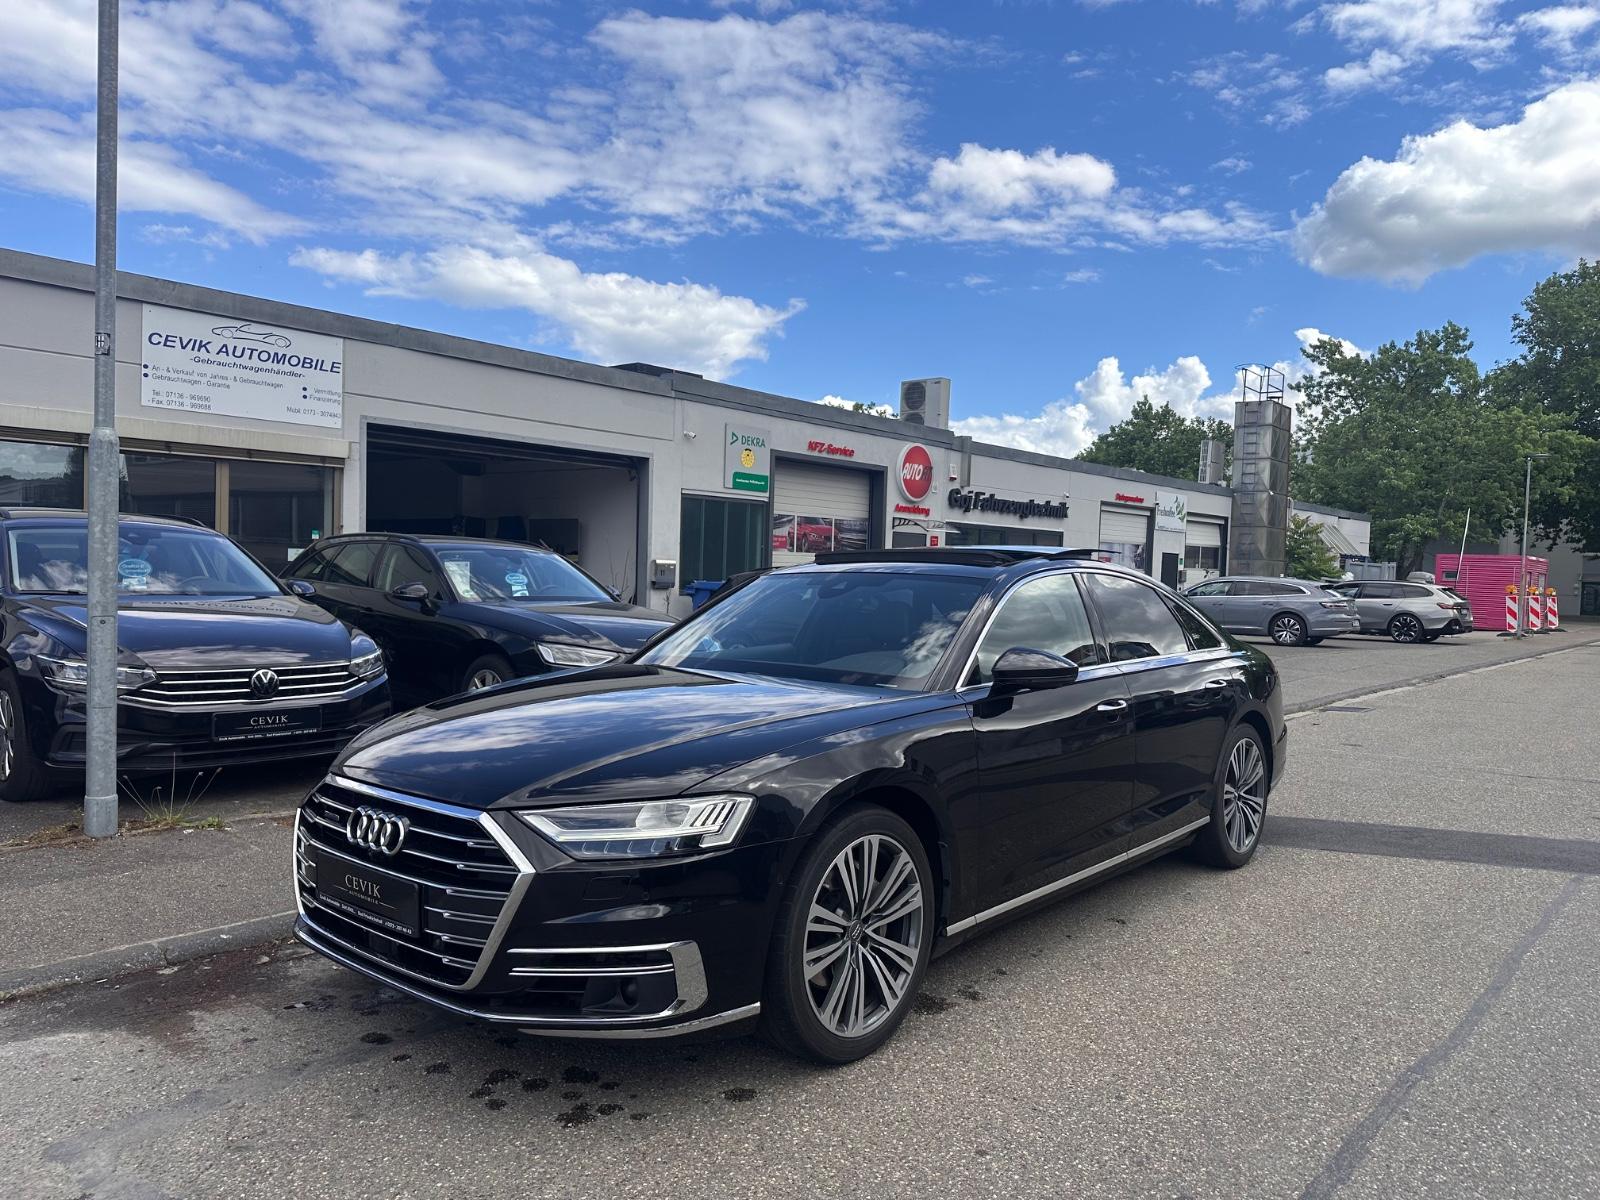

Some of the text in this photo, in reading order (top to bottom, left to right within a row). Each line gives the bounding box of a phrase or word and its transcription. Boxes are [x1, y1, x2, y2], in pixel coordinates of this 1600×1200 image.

[148, 332, 342, 374] CEVIK AUTOMOBILE
[741, 435, 766, 448] DEKRA
[250, 715, 289, 725] CEVIK
[344, 874, 381, 898] CEVIK
